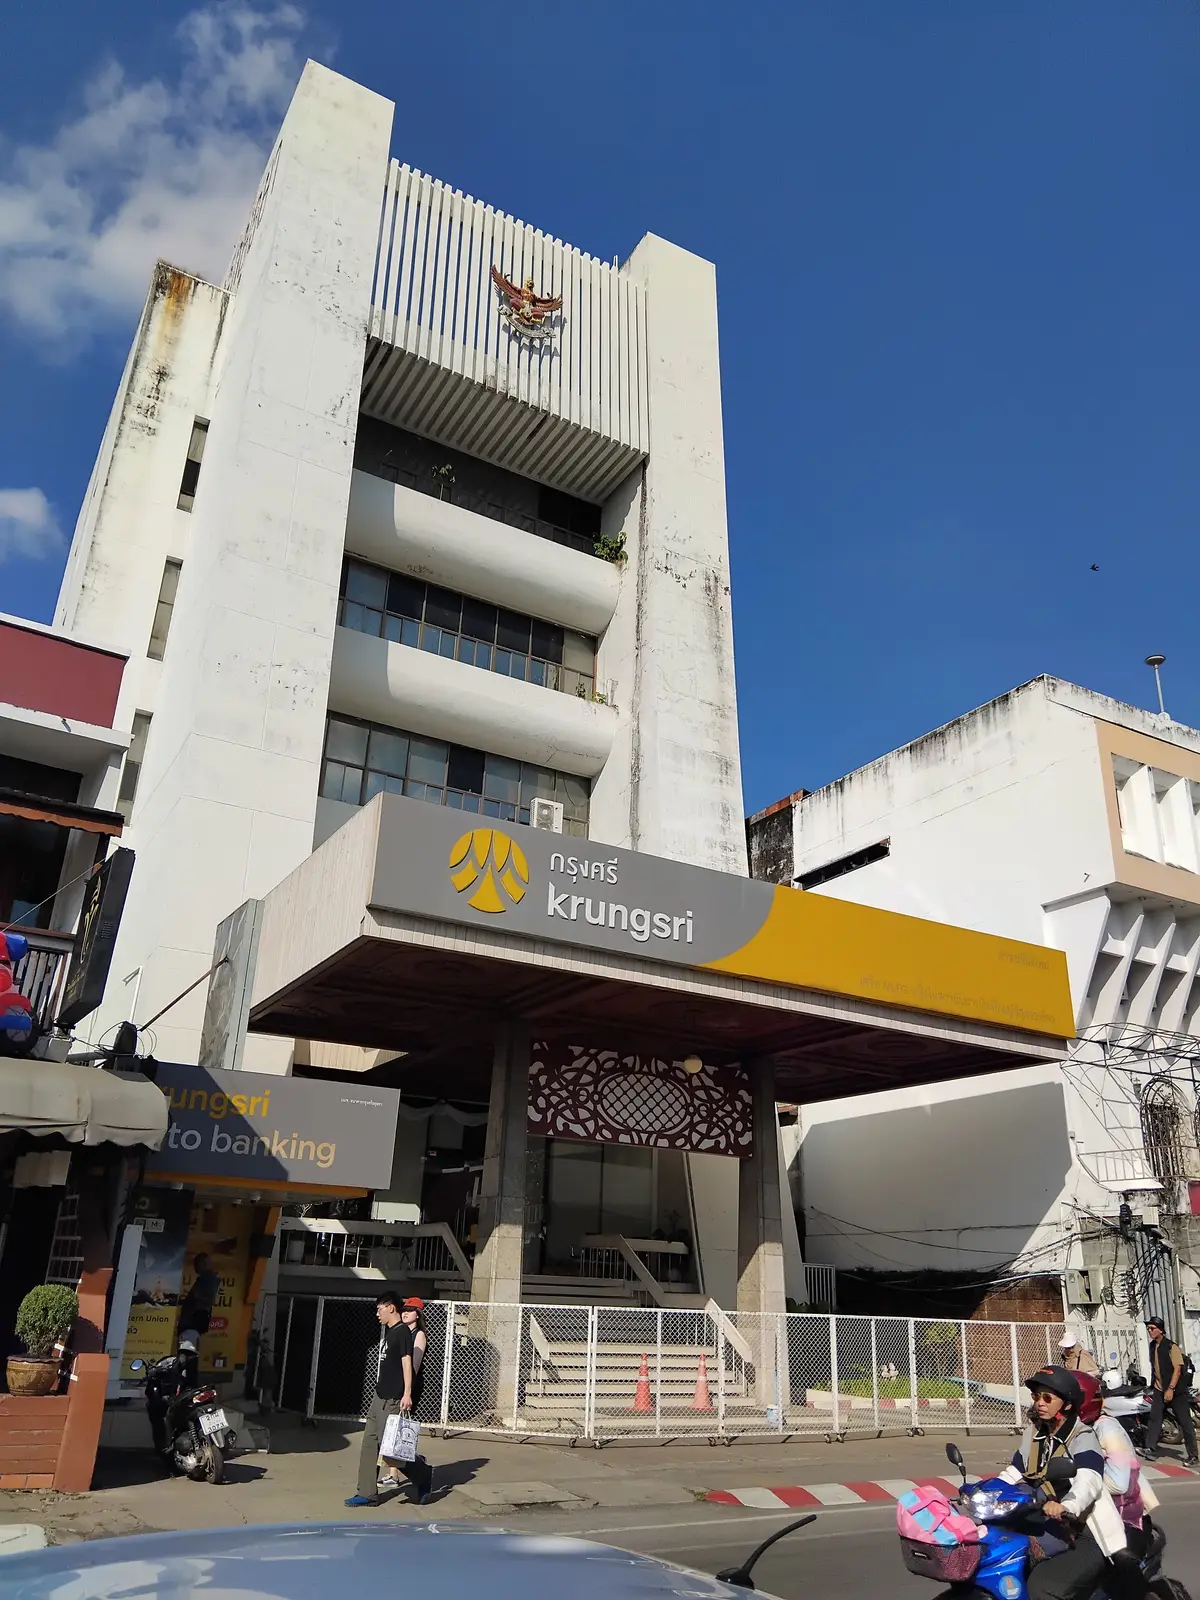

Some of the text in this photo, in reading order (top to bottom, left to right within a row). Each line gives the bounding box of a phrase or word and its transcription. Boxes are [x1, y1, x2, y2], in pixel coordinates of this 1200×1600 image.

[550, 851, 618, 886] กรุงศรี
[547, 882, 694, 943] krungsri
[162, 1087, 271, 1119] ungsri
[168, 1121, 337, 1168] to banking
